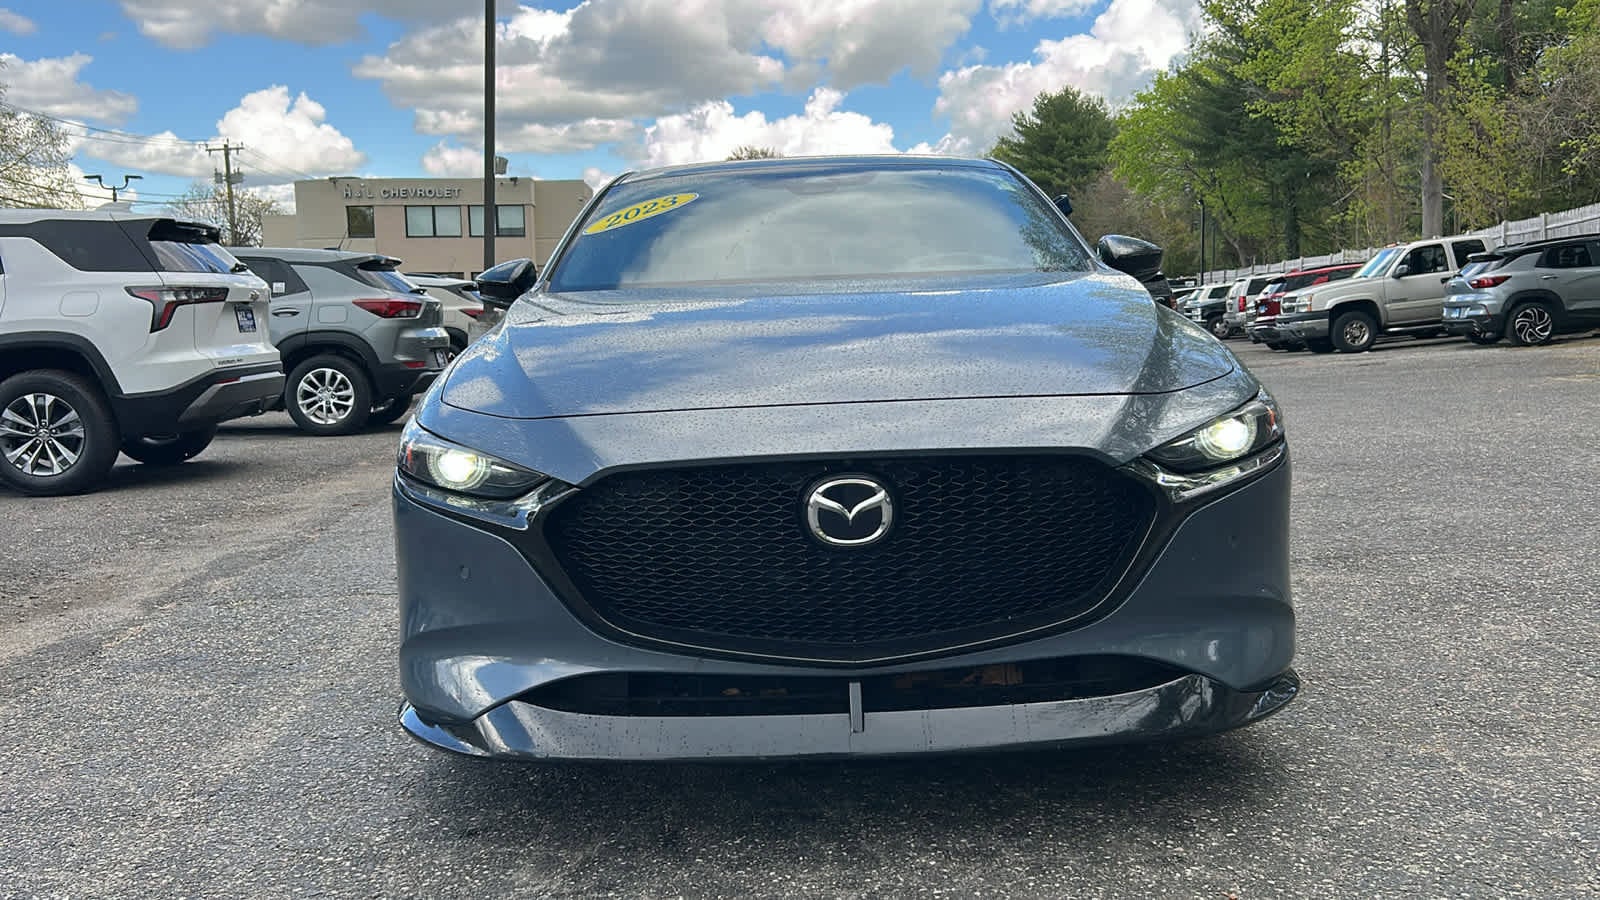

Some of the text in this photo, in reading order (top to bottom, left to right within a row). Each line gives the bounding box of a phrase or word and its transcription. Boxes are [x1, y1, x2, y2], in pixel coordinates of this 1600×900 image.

[343, 187, 352, 198] H
[366, 188, 375, 198] L
[380, 187, 462, 199] CHEVROLET
[605, 196, 678, 228] 2023
